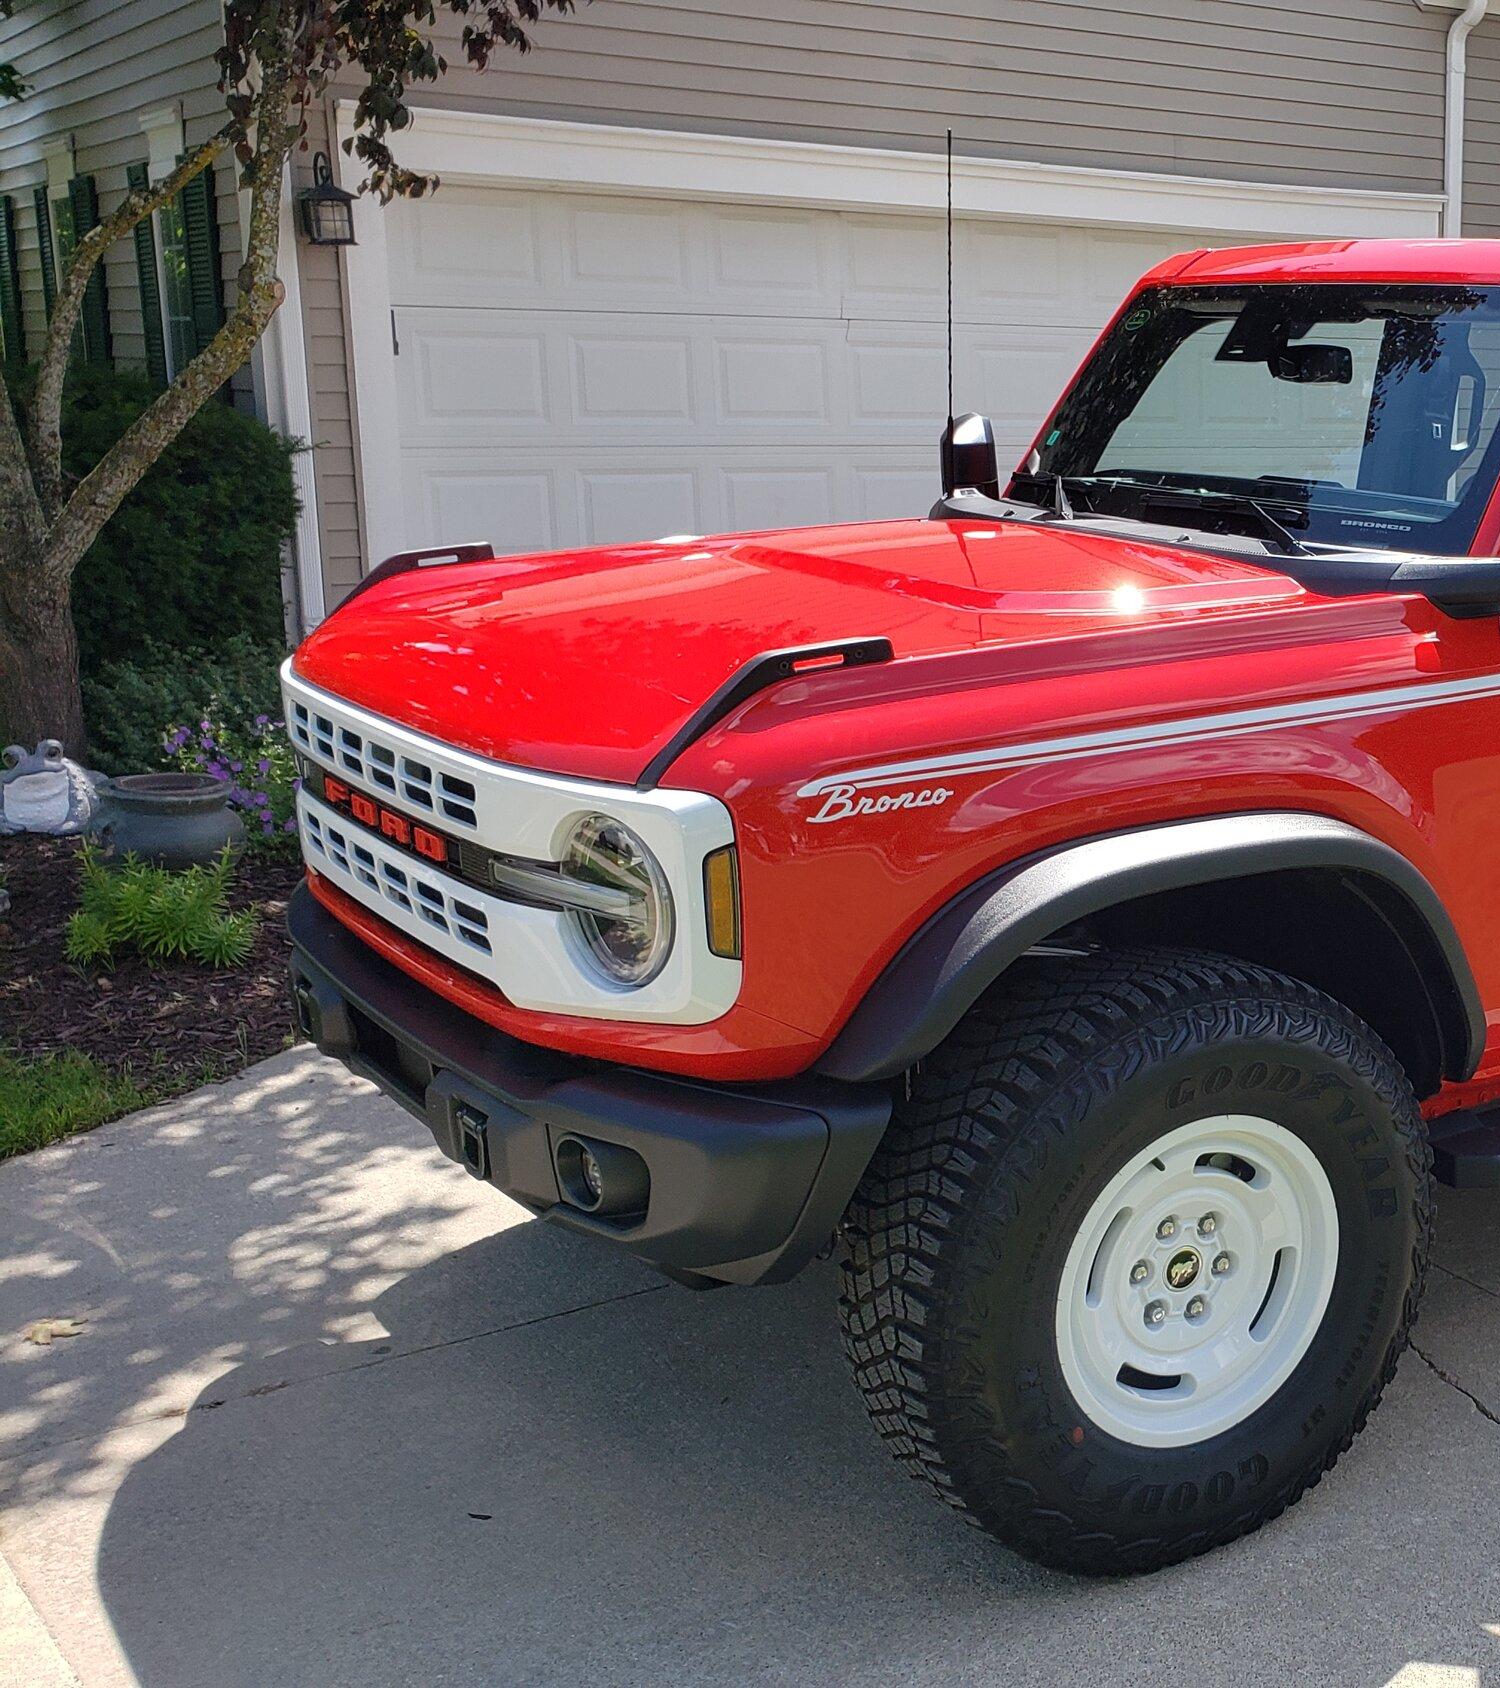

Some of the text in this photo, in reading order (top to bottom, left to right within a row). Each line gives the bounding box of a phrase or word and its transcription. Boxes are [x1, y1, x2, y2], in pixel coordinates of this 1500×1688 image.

[1340, 519, 1412, 532] BRONCO
[324, 776, 447, 862] FORD
[806, 785, 954, 823] Bronco
[1165, 1060, 1396, 1219] GOODYEAR
